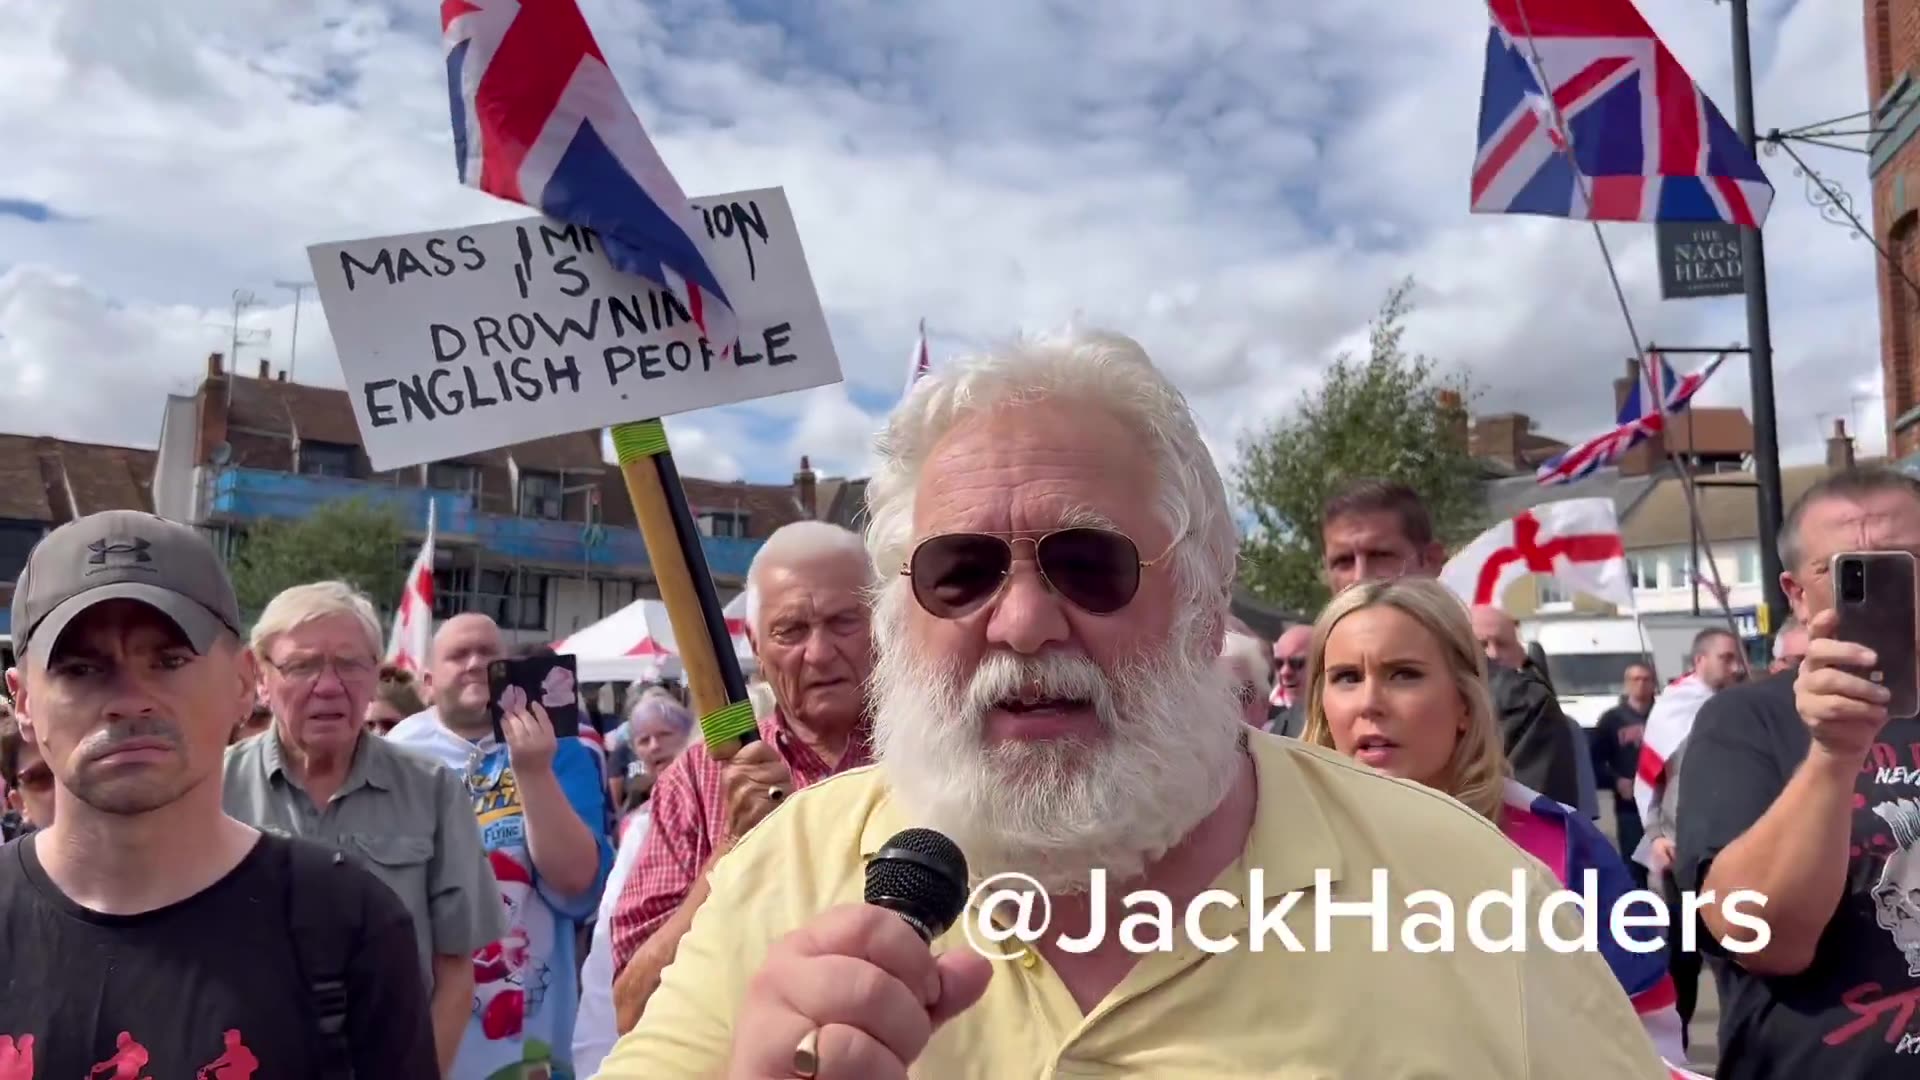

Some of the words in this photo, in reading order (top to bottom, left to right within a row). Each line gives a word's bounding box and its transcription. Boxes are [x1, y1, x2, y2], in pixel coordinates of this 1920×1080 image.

[1674, 241, 1740, 261] NAGS
[1690, 230, 1721, 242] THE
[340, 235, 485, 291] MASS
[514, 256, 590, 298] IS
[1674, 261, 1742, 281] HEAD
[431, 288, 693, 362] DROWNIN
[364, 356, 581, 427] ENGLISH
